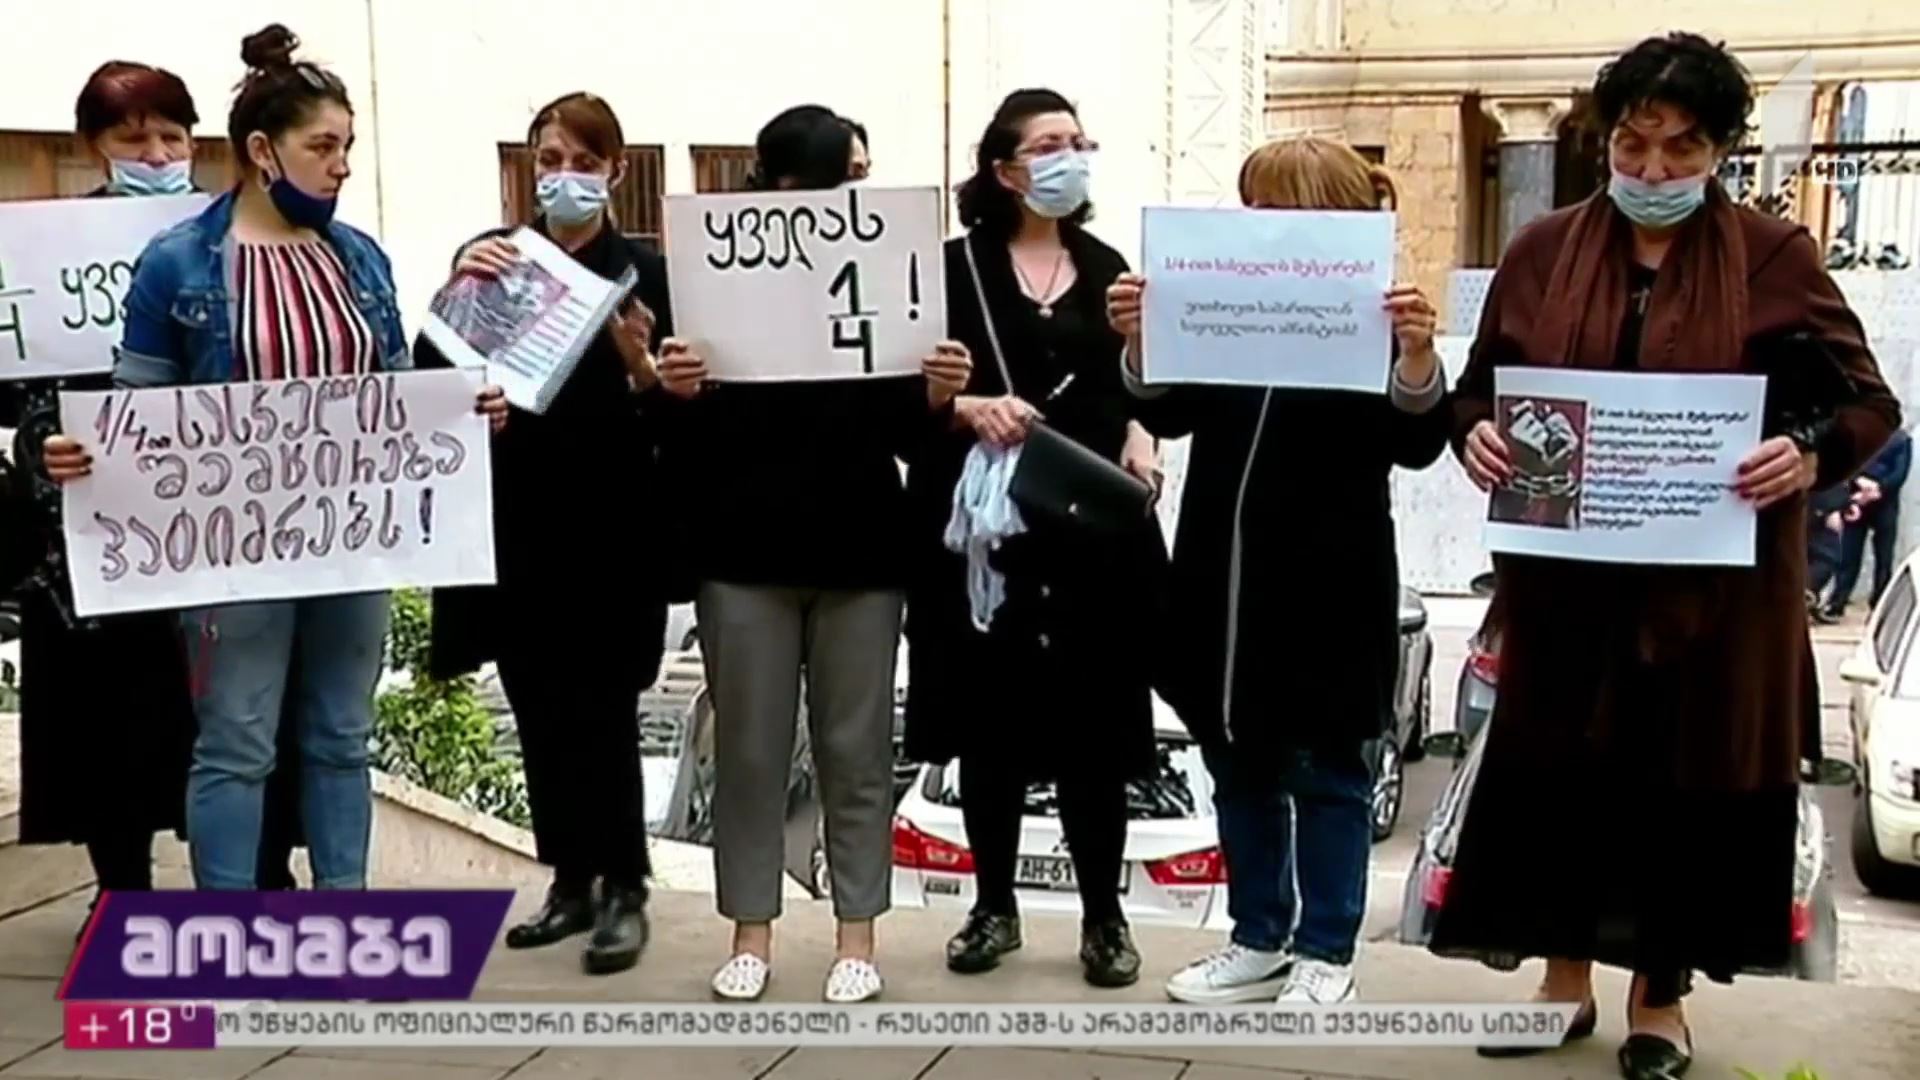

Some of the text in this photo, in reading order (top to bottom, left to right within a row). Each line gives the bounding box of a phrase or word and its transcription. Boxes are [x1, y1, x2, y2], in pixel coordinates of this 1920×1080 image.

[705, 189, 885, 271] ყველას
[175, 375, 407, 448] სასჯელის
[136, 430, 466, 500] შემცირება
